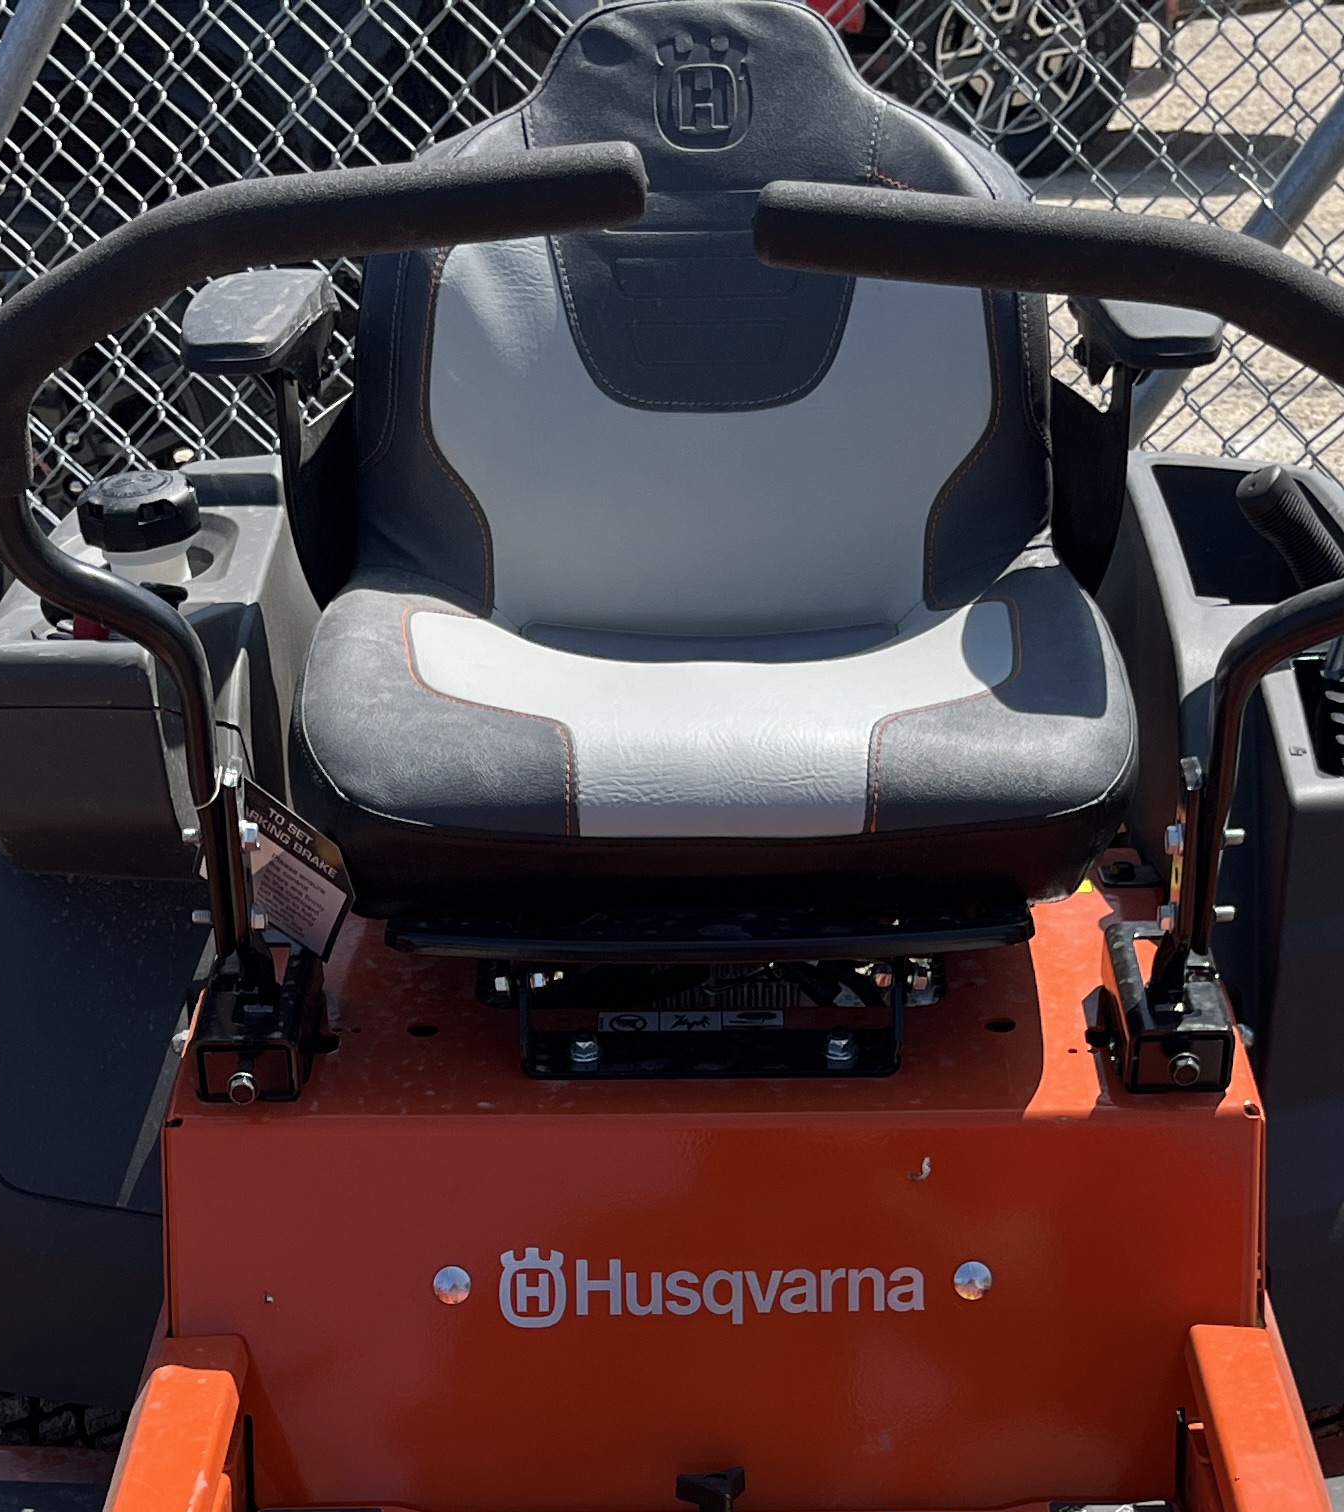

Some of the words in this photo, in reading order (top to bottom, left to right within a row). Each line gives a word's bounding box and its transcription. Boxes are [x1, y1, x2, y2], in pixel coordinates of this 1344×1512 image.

[245, 805, 291, 845] RKING
[292, 842, 338, 880] BRAKE
[268, 807, 286, 826] TO
[286, 823, 314, 846] SET
[574, 1257, 926, 1326] Husqvarna
